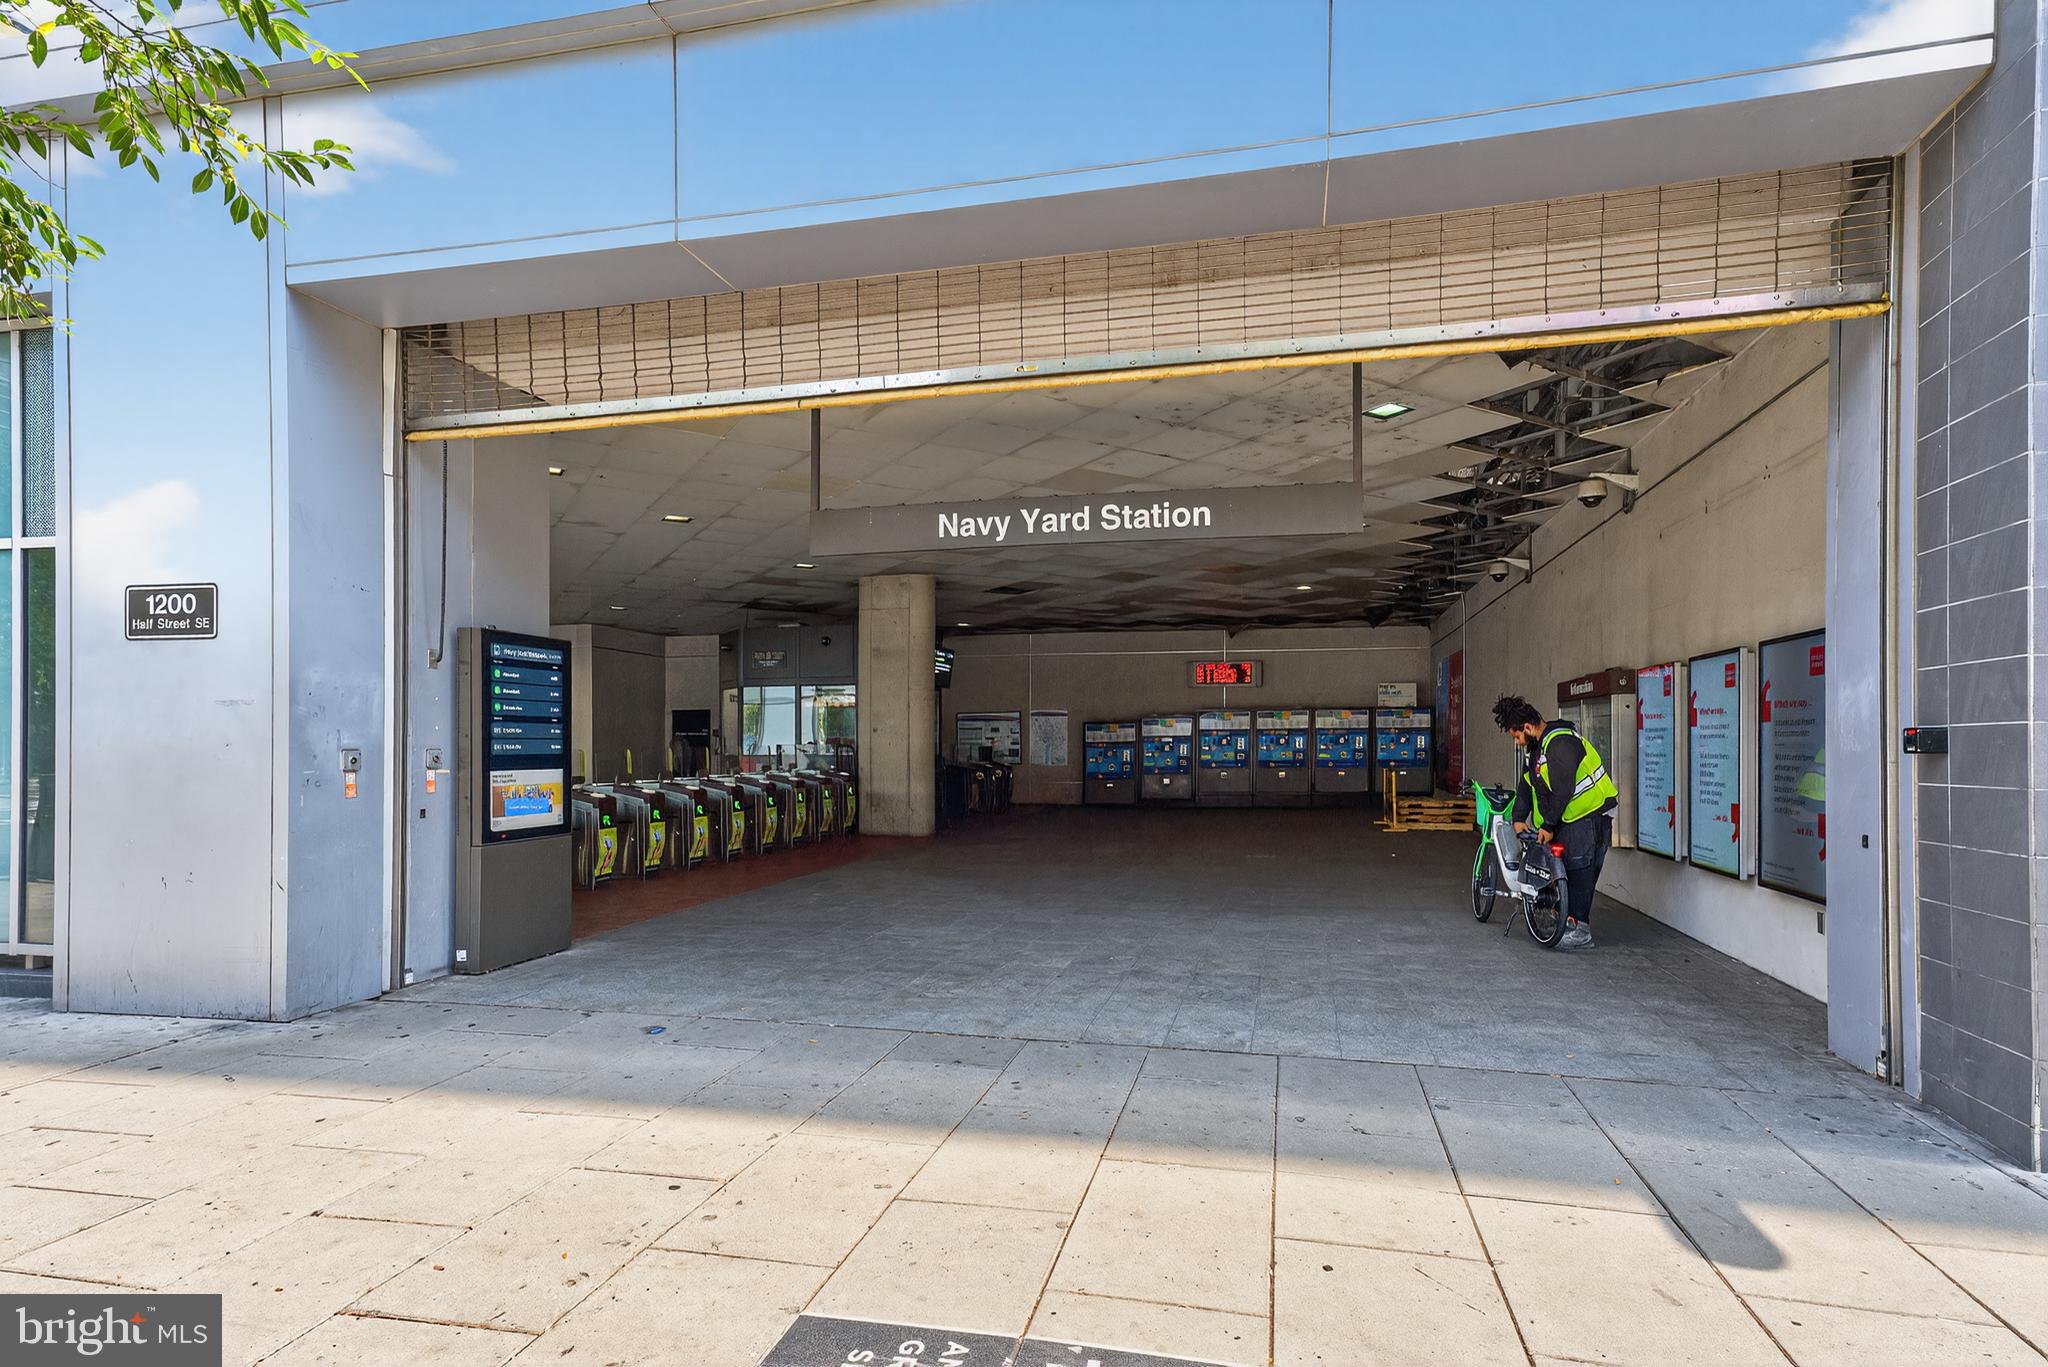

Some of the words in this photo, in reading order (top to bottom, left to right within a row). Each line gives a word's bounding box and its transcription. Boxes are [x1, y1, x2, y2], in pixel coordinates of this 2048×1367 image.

[938, 512, 1012, 542] Navy
[1019, 505, 1090, 534] Yard
[1100, 501, 1212, 531] Station
[145, 592, 197, 615] 1200
[132, 618, 154, 631] Half
[157, 617, 191, 630] Street
[194, 616, 211, 629] SE
